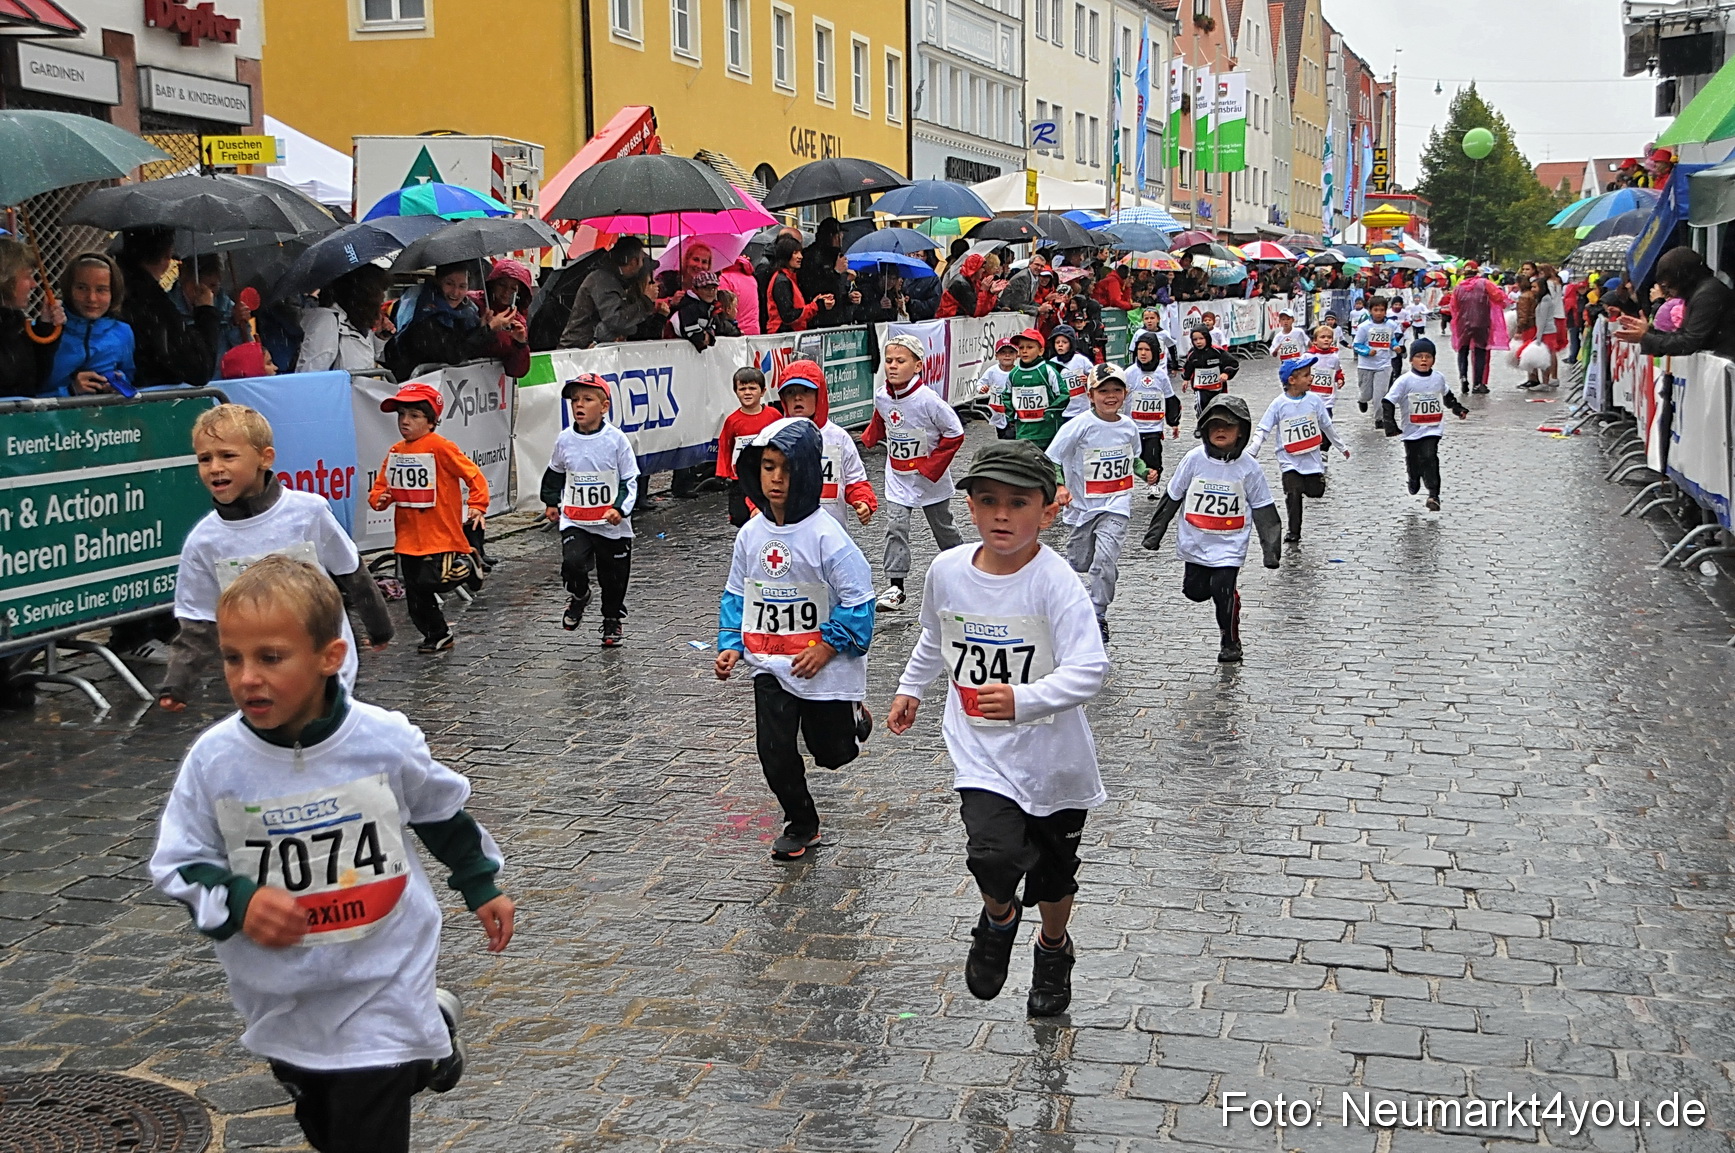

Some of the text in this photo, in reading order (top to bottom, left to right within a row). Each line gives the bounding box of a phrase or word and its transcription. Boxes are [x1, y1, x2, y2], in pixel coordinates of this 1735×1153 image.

[30, 61, 85, 82] GARDINEN
[155, 84, 247, 110] BABY & KINDERMODEN
[217, 139, 263, 150] Duschen
[790, 125, 816, 159] CAFE
[221, 151, 260, 161] Freibad
[445, 372, 507, 426] Xplus1
[1016, 395, 1043, 409] 7052
[1135, 400, 1162, 411] 7044
[1412, 400, 1441, 413] 7063
[7, 428, 141, 456] Event-Leit-Systeme
[1284, 421, 1317, 443] 7165
[472, 442, 507, 468] Neumarkt
[389, 467, 429, 488] 7198
[1090, 457, 1130, 480] 7350
[19, 497, 39, 529] &
[45, 488, 118, 526] Action
[125, 482, 145, 513] in
[569, 484, 611, 506] 7160
[1193, 492, 1241, 516] 7254
[74, 520, 163, 565] Bahnen!
[7, 571, 179, 628] & Service Line: 09181 635
[761, 587, 798, 597] BOCK
[752, 601, 818, 634] 7319
[964, 621, 1009, 637] BOCK
[951, 641, 1036, 686] 7347
[262, 797, 341, 826] BOCK
[244, 821, 388, 892] 7074
[306, 899, 367, 927] axim
